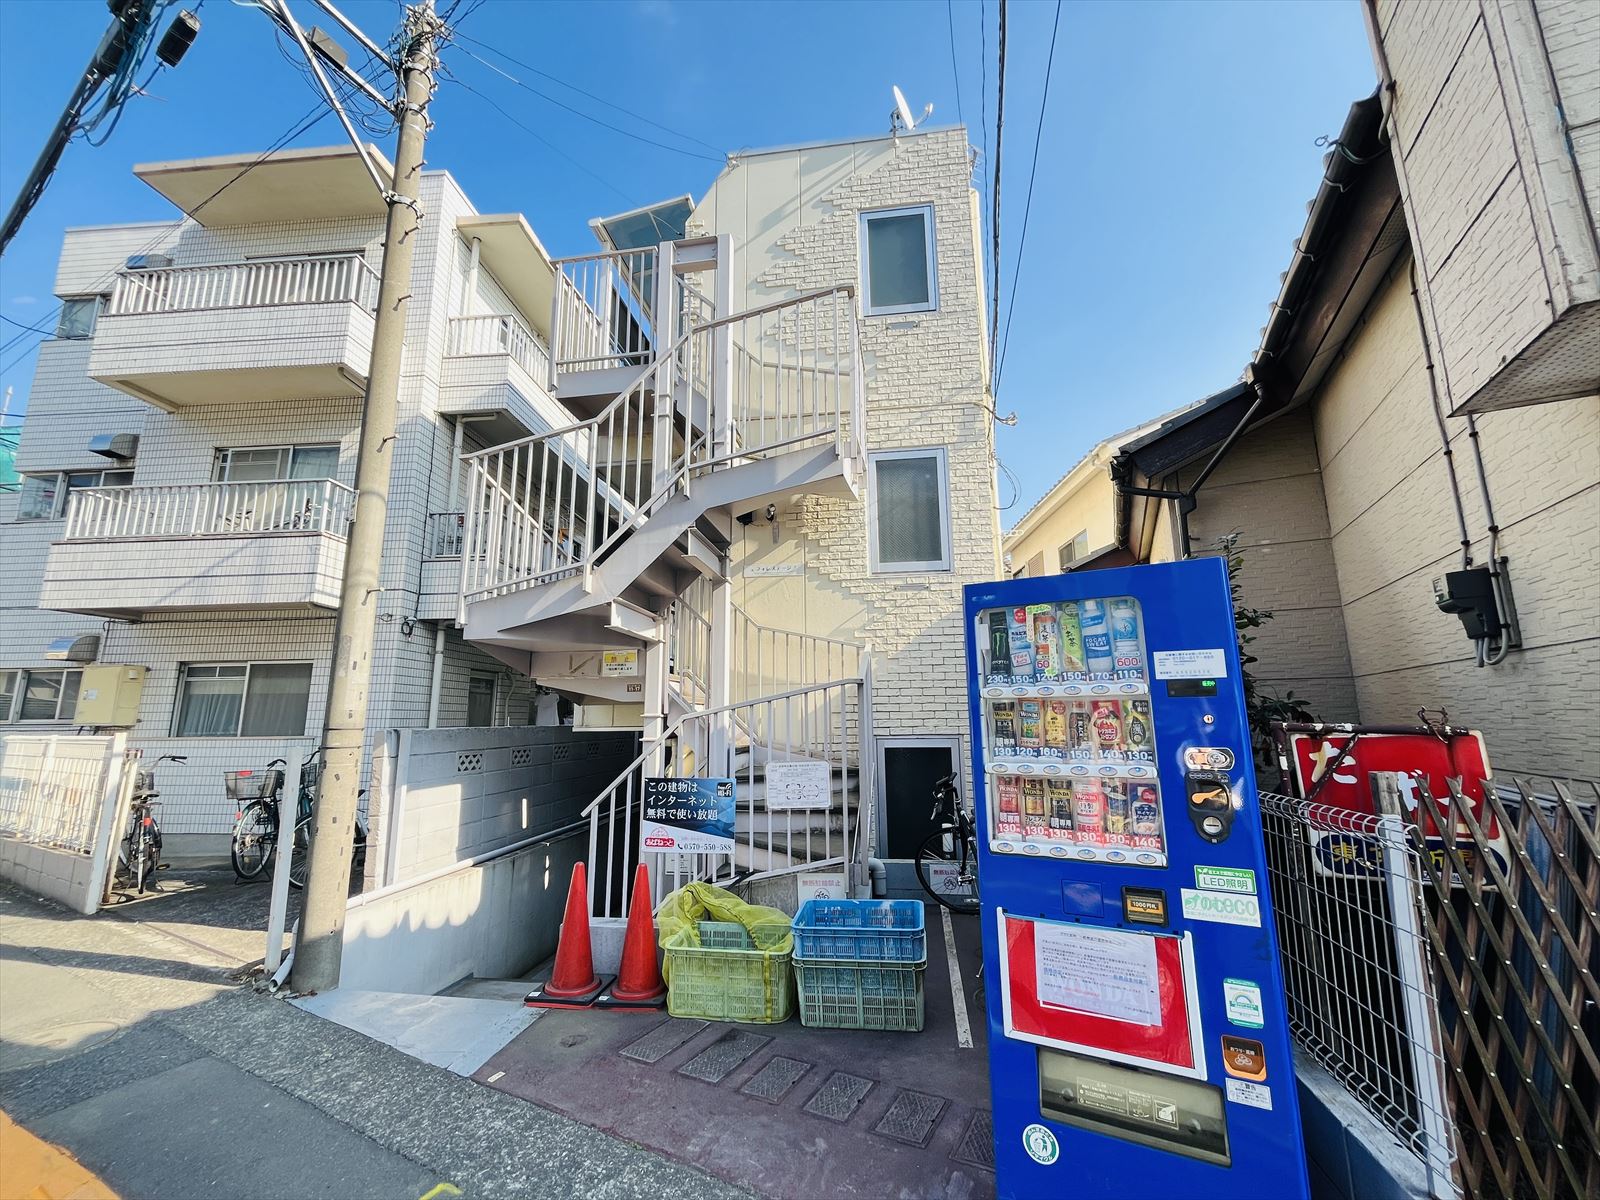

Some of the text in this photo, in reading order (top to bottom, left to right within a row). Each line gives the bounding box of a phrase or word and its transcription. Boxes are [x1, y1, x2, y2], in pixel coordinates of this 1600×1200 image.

[648, 781, 698, 793] この建物は
[647, 794, 717, 807] インターネット
[646, 808, 718, 820] 無料で使い放題
[683, 843, 732, 851] 0570-550-588
[1203, 877, 1248, 890] LED照明
